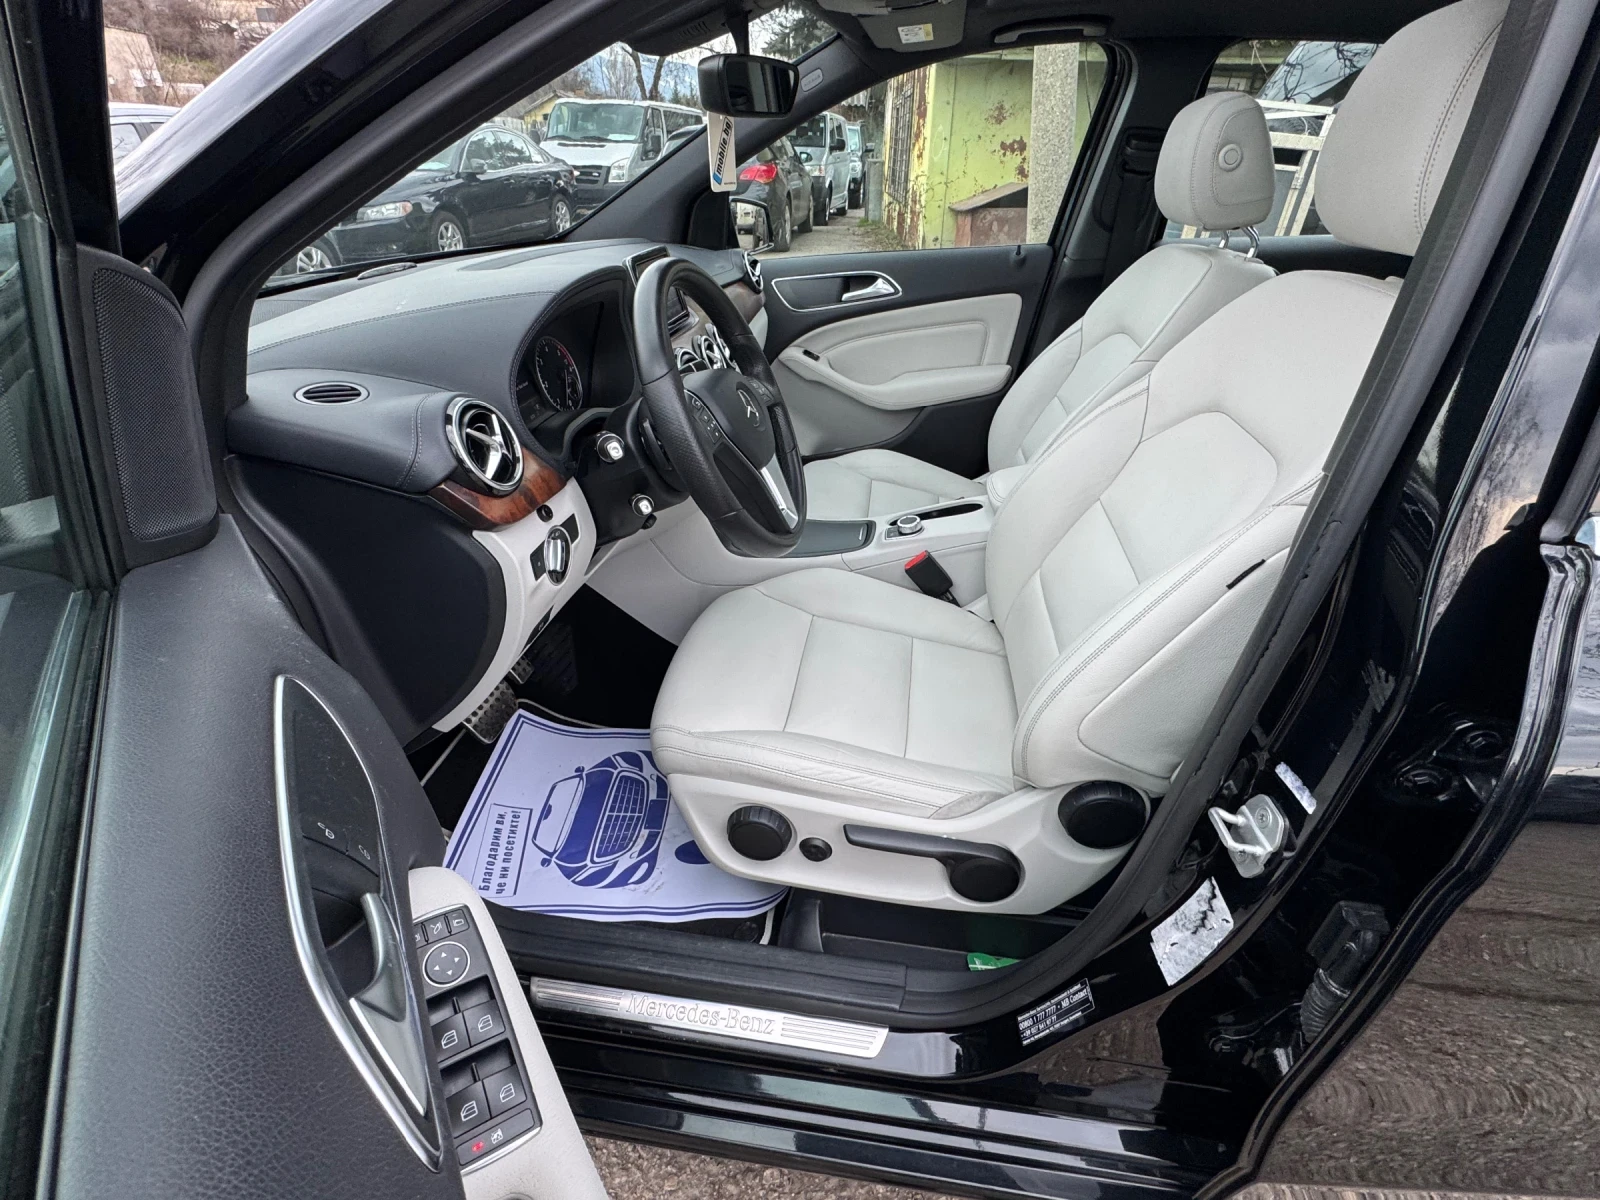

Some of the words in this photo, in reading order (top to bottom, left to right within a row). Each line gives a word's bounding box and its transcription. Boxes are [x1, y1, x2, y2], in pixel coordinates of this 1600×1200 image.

[716, 121, 732, 175] mobile.bg
[478, 827, 503, 892] Благодарим
[495, 811, 508, 825] ви,
[502, 810, 522, 863] посетихте!
[495, 881, 507, 894] че
[499, 865, 510, 879] ни
[626, 993, 776, 1035] Mercedes-Benz
[1069, 988, 1088, 1004] Contact
